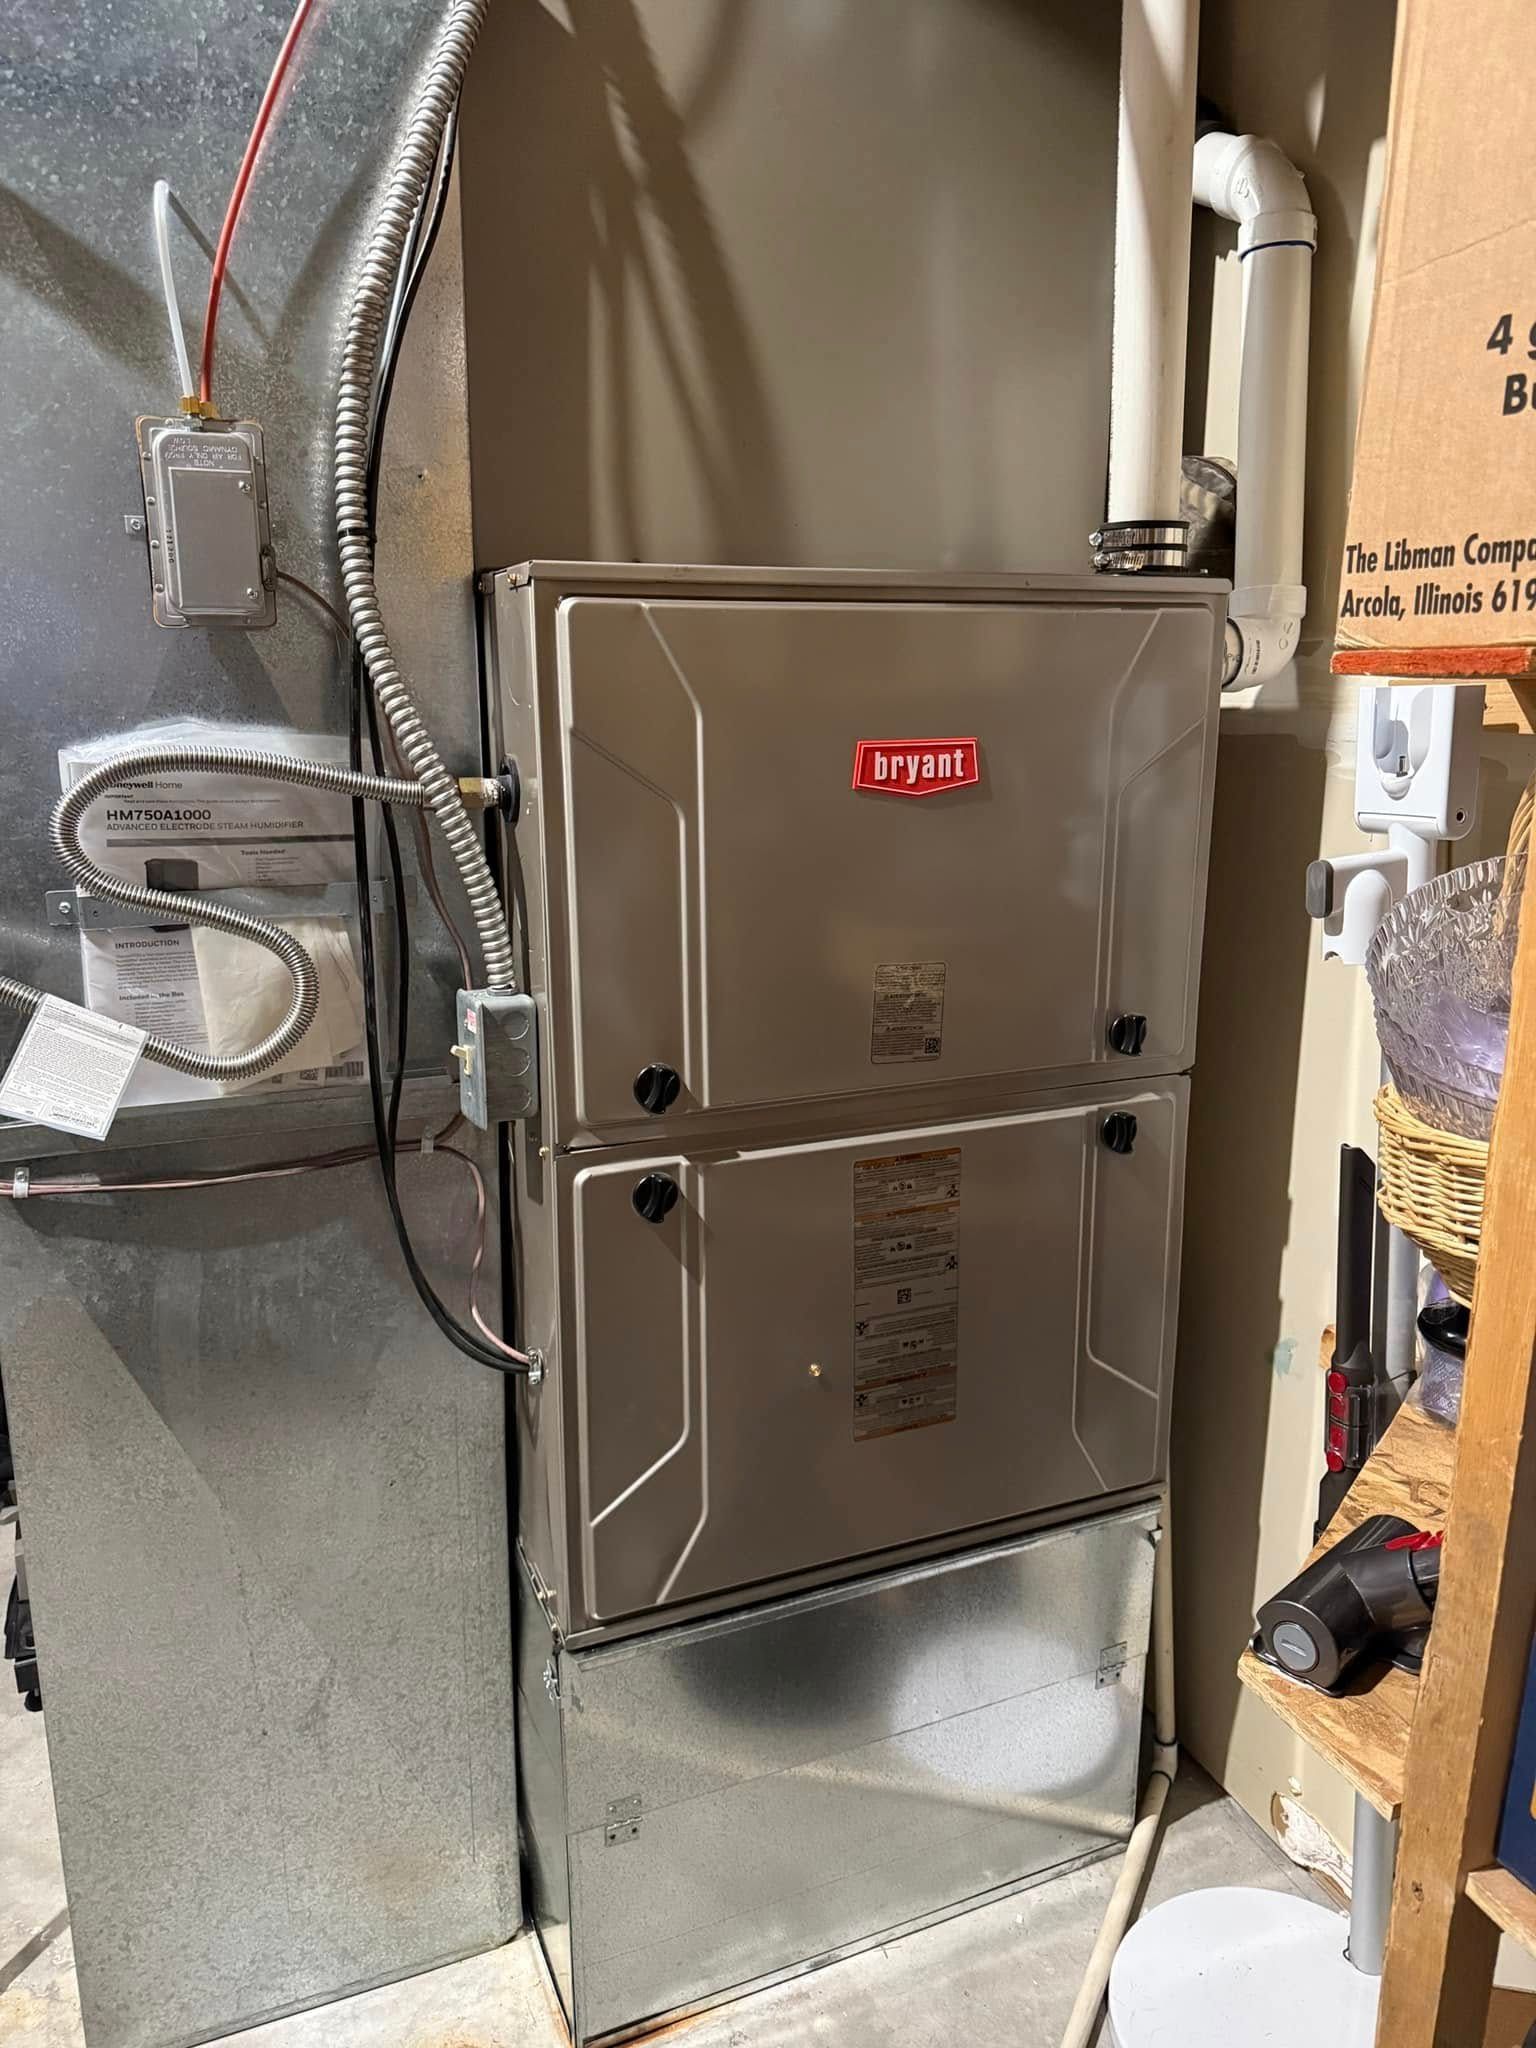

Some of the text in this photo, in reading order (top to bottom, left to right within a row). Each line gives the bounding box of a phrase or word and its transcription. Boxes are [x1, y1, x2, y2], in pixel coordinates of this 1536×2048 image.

[1487, 313, 1513, 355] 4
[1346, 542, 1378, 574] The
[1384, 538, 1456, 572] Libman
[1340, 585, 1406, 621] Arcola,
[1413, 582, 1483, 616] Illinois
[874, 749, 965, 784] bryant
[155, 781, 183, 789] Home
[106, 809, 212, 821] HM750A1000
[106, 820, 304, 832] ADVANCED ELECTRODE STEAM HUMIDIFIER
[115, 939, 180, 949] INTRODUCTION
